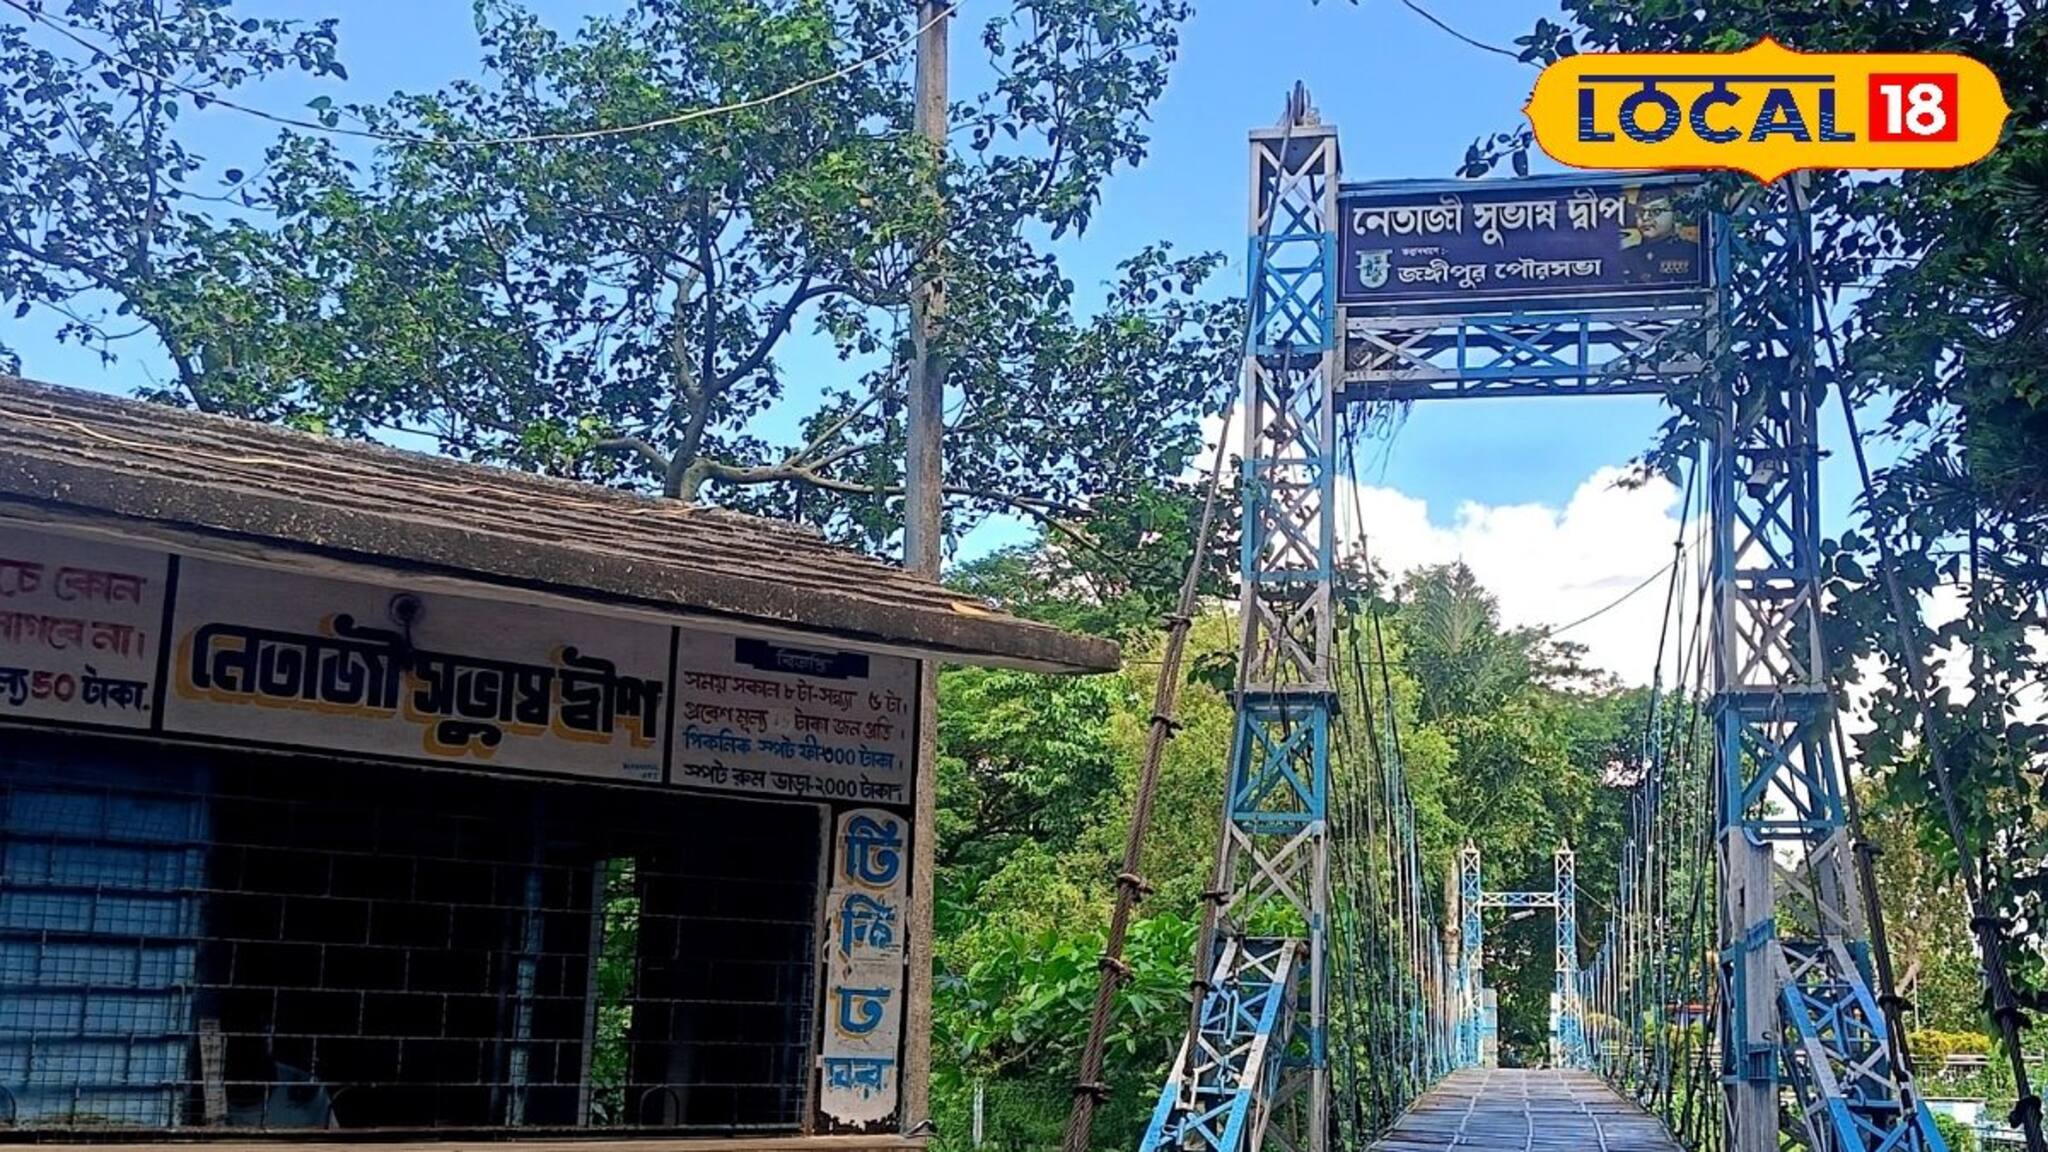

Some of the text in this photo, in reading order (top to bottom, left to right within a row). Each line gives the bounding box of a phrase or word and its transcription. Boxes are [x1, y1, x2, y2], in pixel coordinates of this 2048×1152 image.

[1353, 189, 1628, 248] নেতাজী সুভাষ দ্বীপ
[1397, 256, 1602, 289] জঙ্গীপুর পৌরসভা
[55, 566, 147, 605] কোন
[191, 613, 663, 747] নেতাজী সুভাষ দ্বীপ
[795, 706, 830, 734] টাকা
[833, 718, 863, 737] জন
[683, 724, 753, 754] পিকনিক
[683, 759, 729, 784] স্পট
[731, 766, 767, 788] রুম
